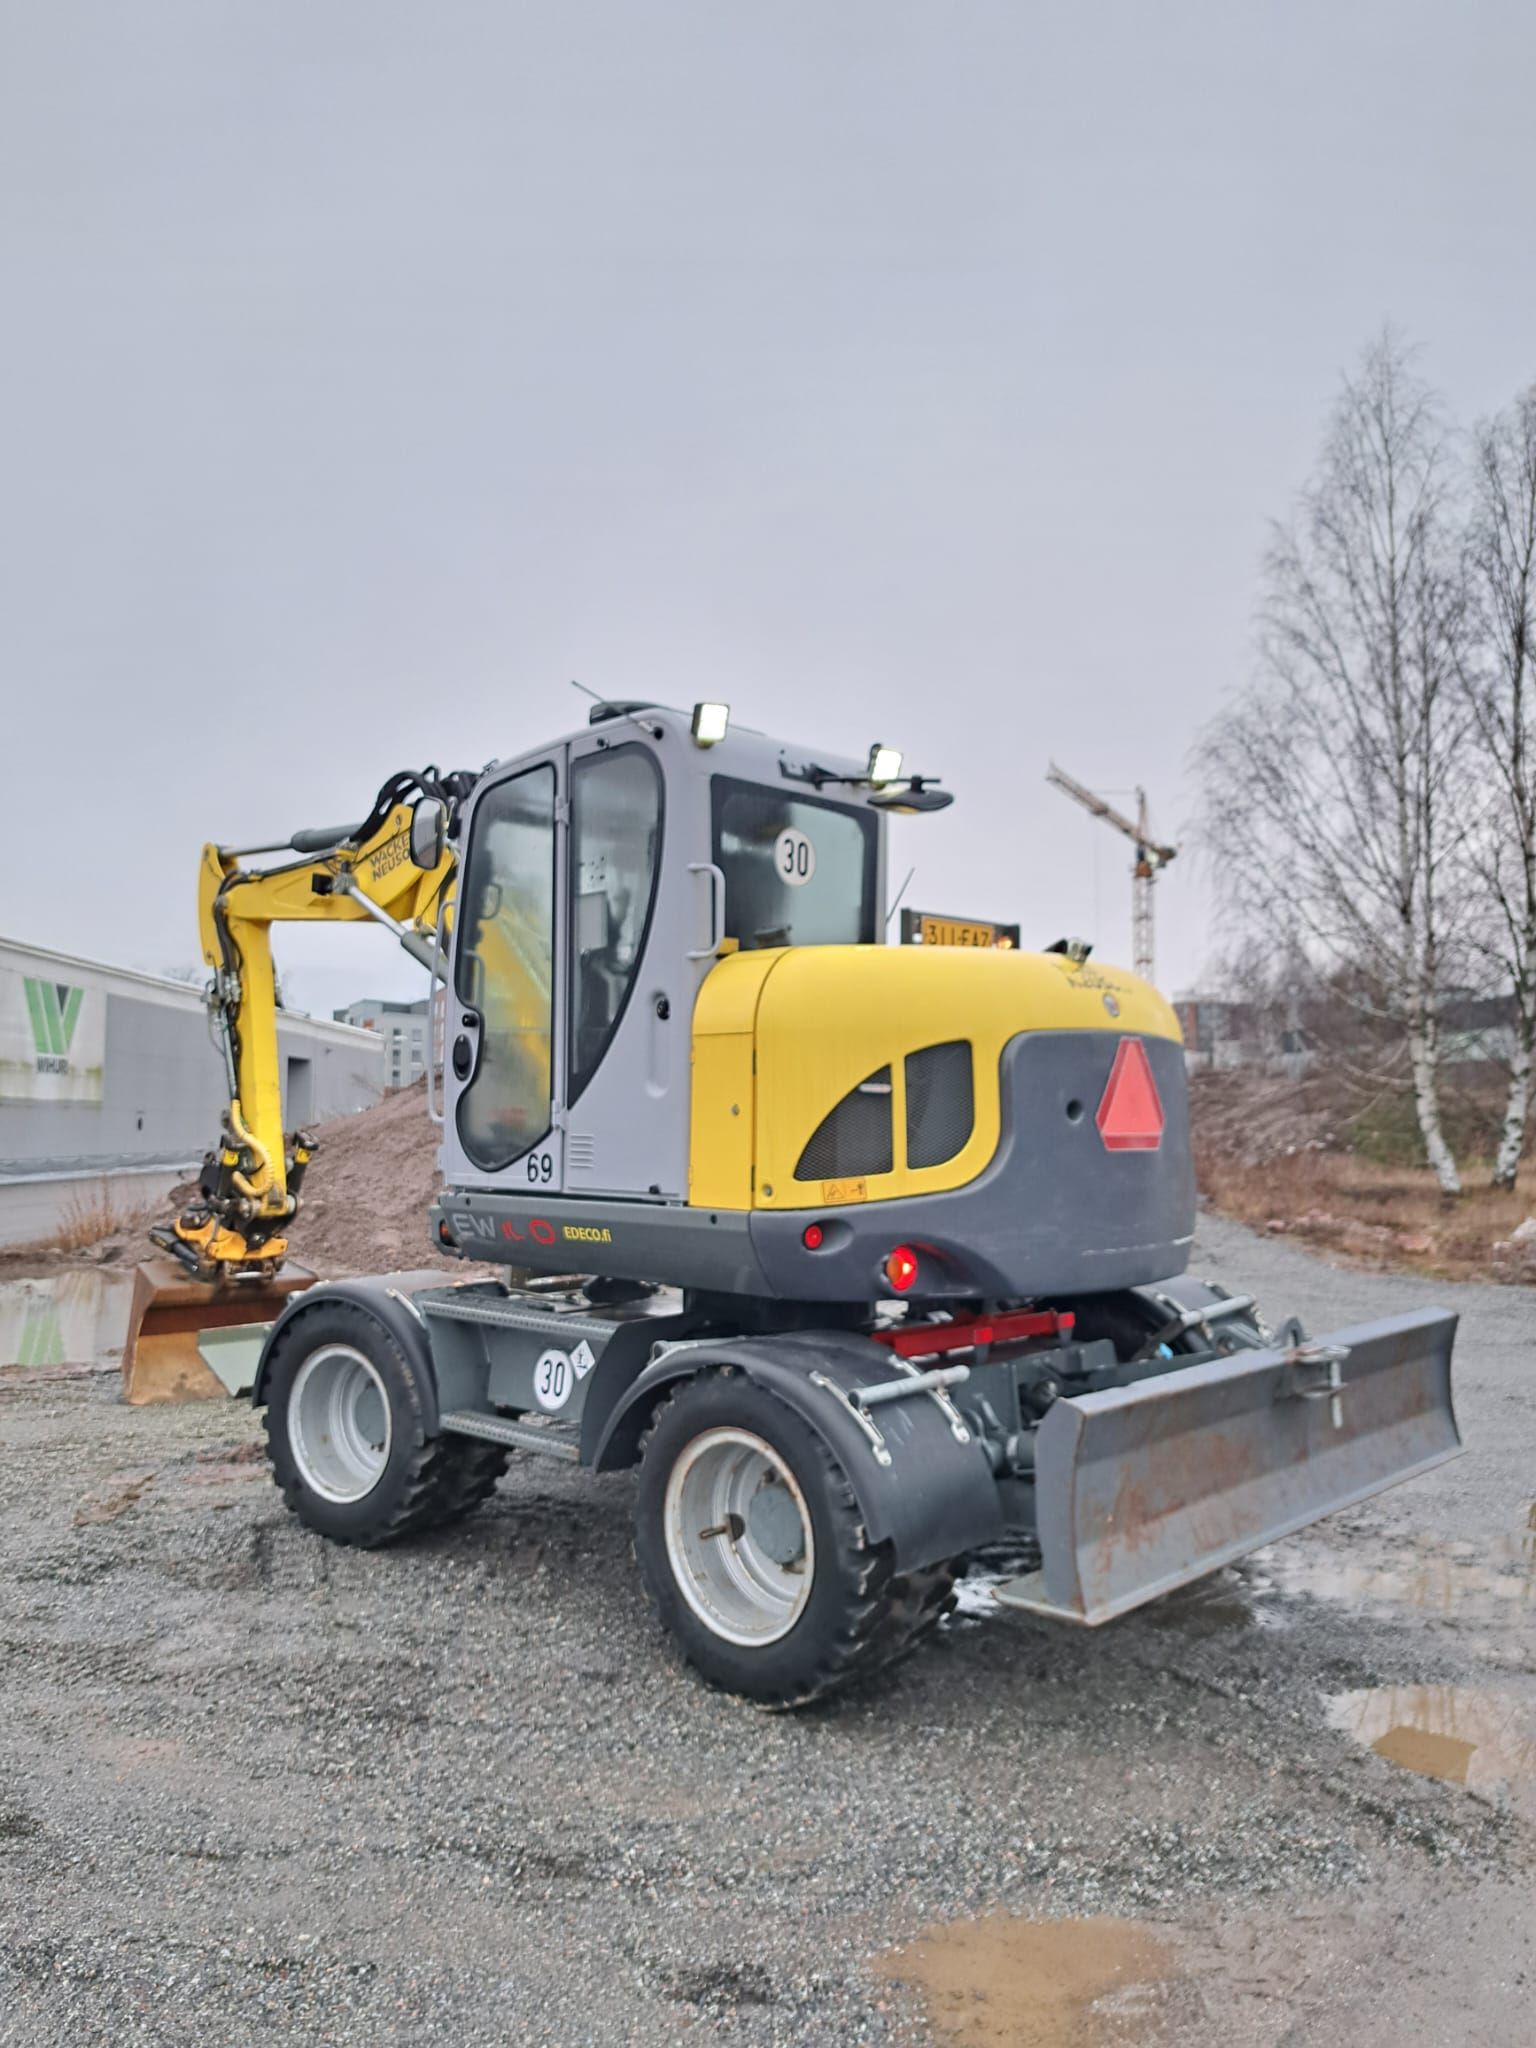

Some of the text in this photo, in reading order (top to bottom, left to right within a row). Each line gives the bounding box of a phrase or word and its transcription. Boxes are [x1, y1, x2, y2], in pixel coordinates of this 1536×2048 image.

[370, 832, 409, 867] WACKE
[372, 847, 410, 882] NEUSO
[783, 838, 809, 876] 30
[527, 1153, 552, 1183] 69
[562, 1225, 612, 1243] EDECO.fi
[541, 1358, 565, 1397] 30
